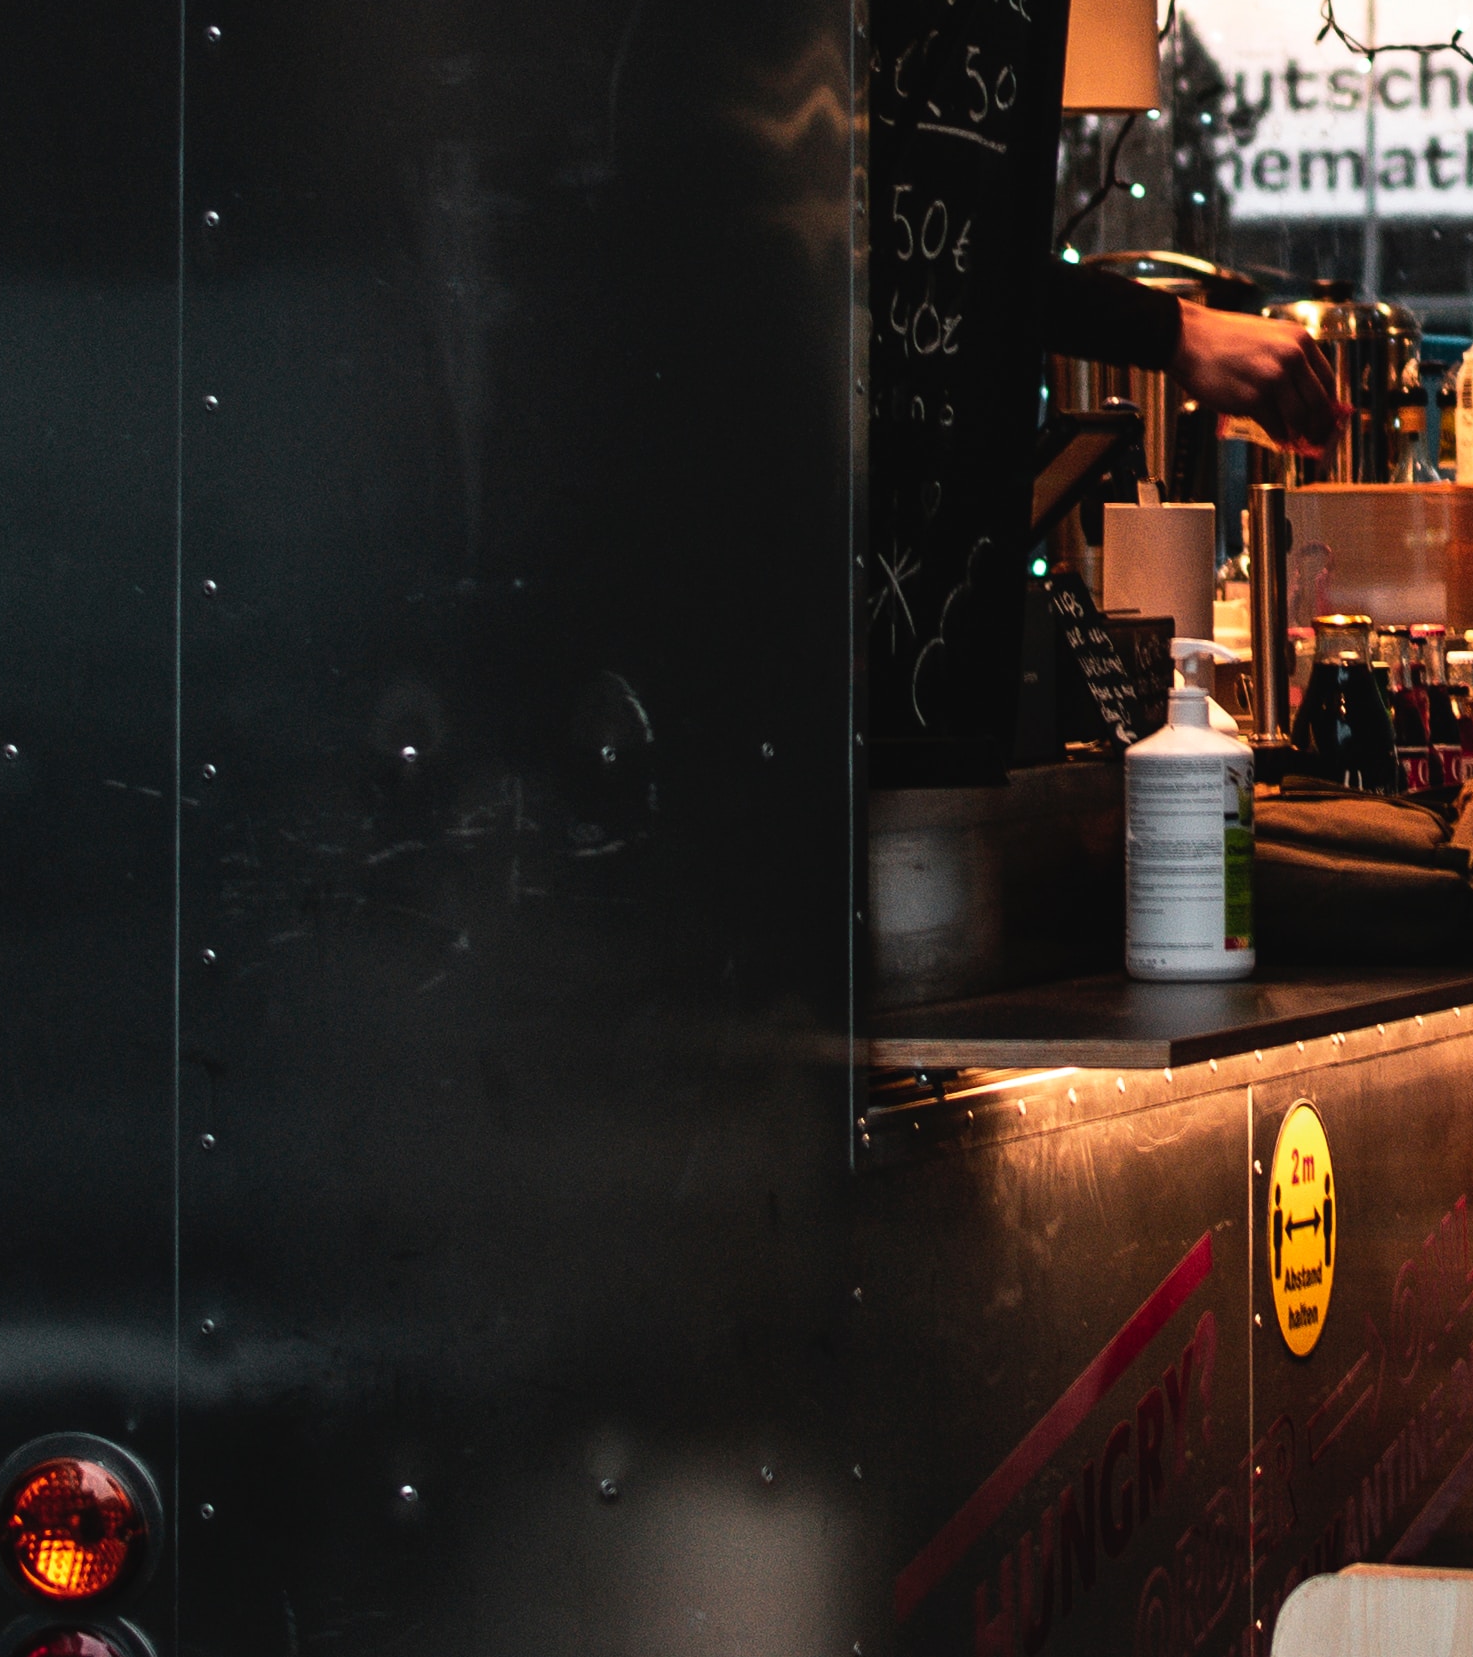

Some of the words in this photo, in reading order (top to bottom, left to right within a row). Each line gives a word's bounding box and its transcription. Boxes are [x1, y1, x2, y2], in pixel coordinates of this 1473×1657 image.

[1284, 1261, 1323, 1293] Abstand
[1288, 1302, 1319, 1331] halten
[975, 1309, 1218, 1657] HUNGRY?
